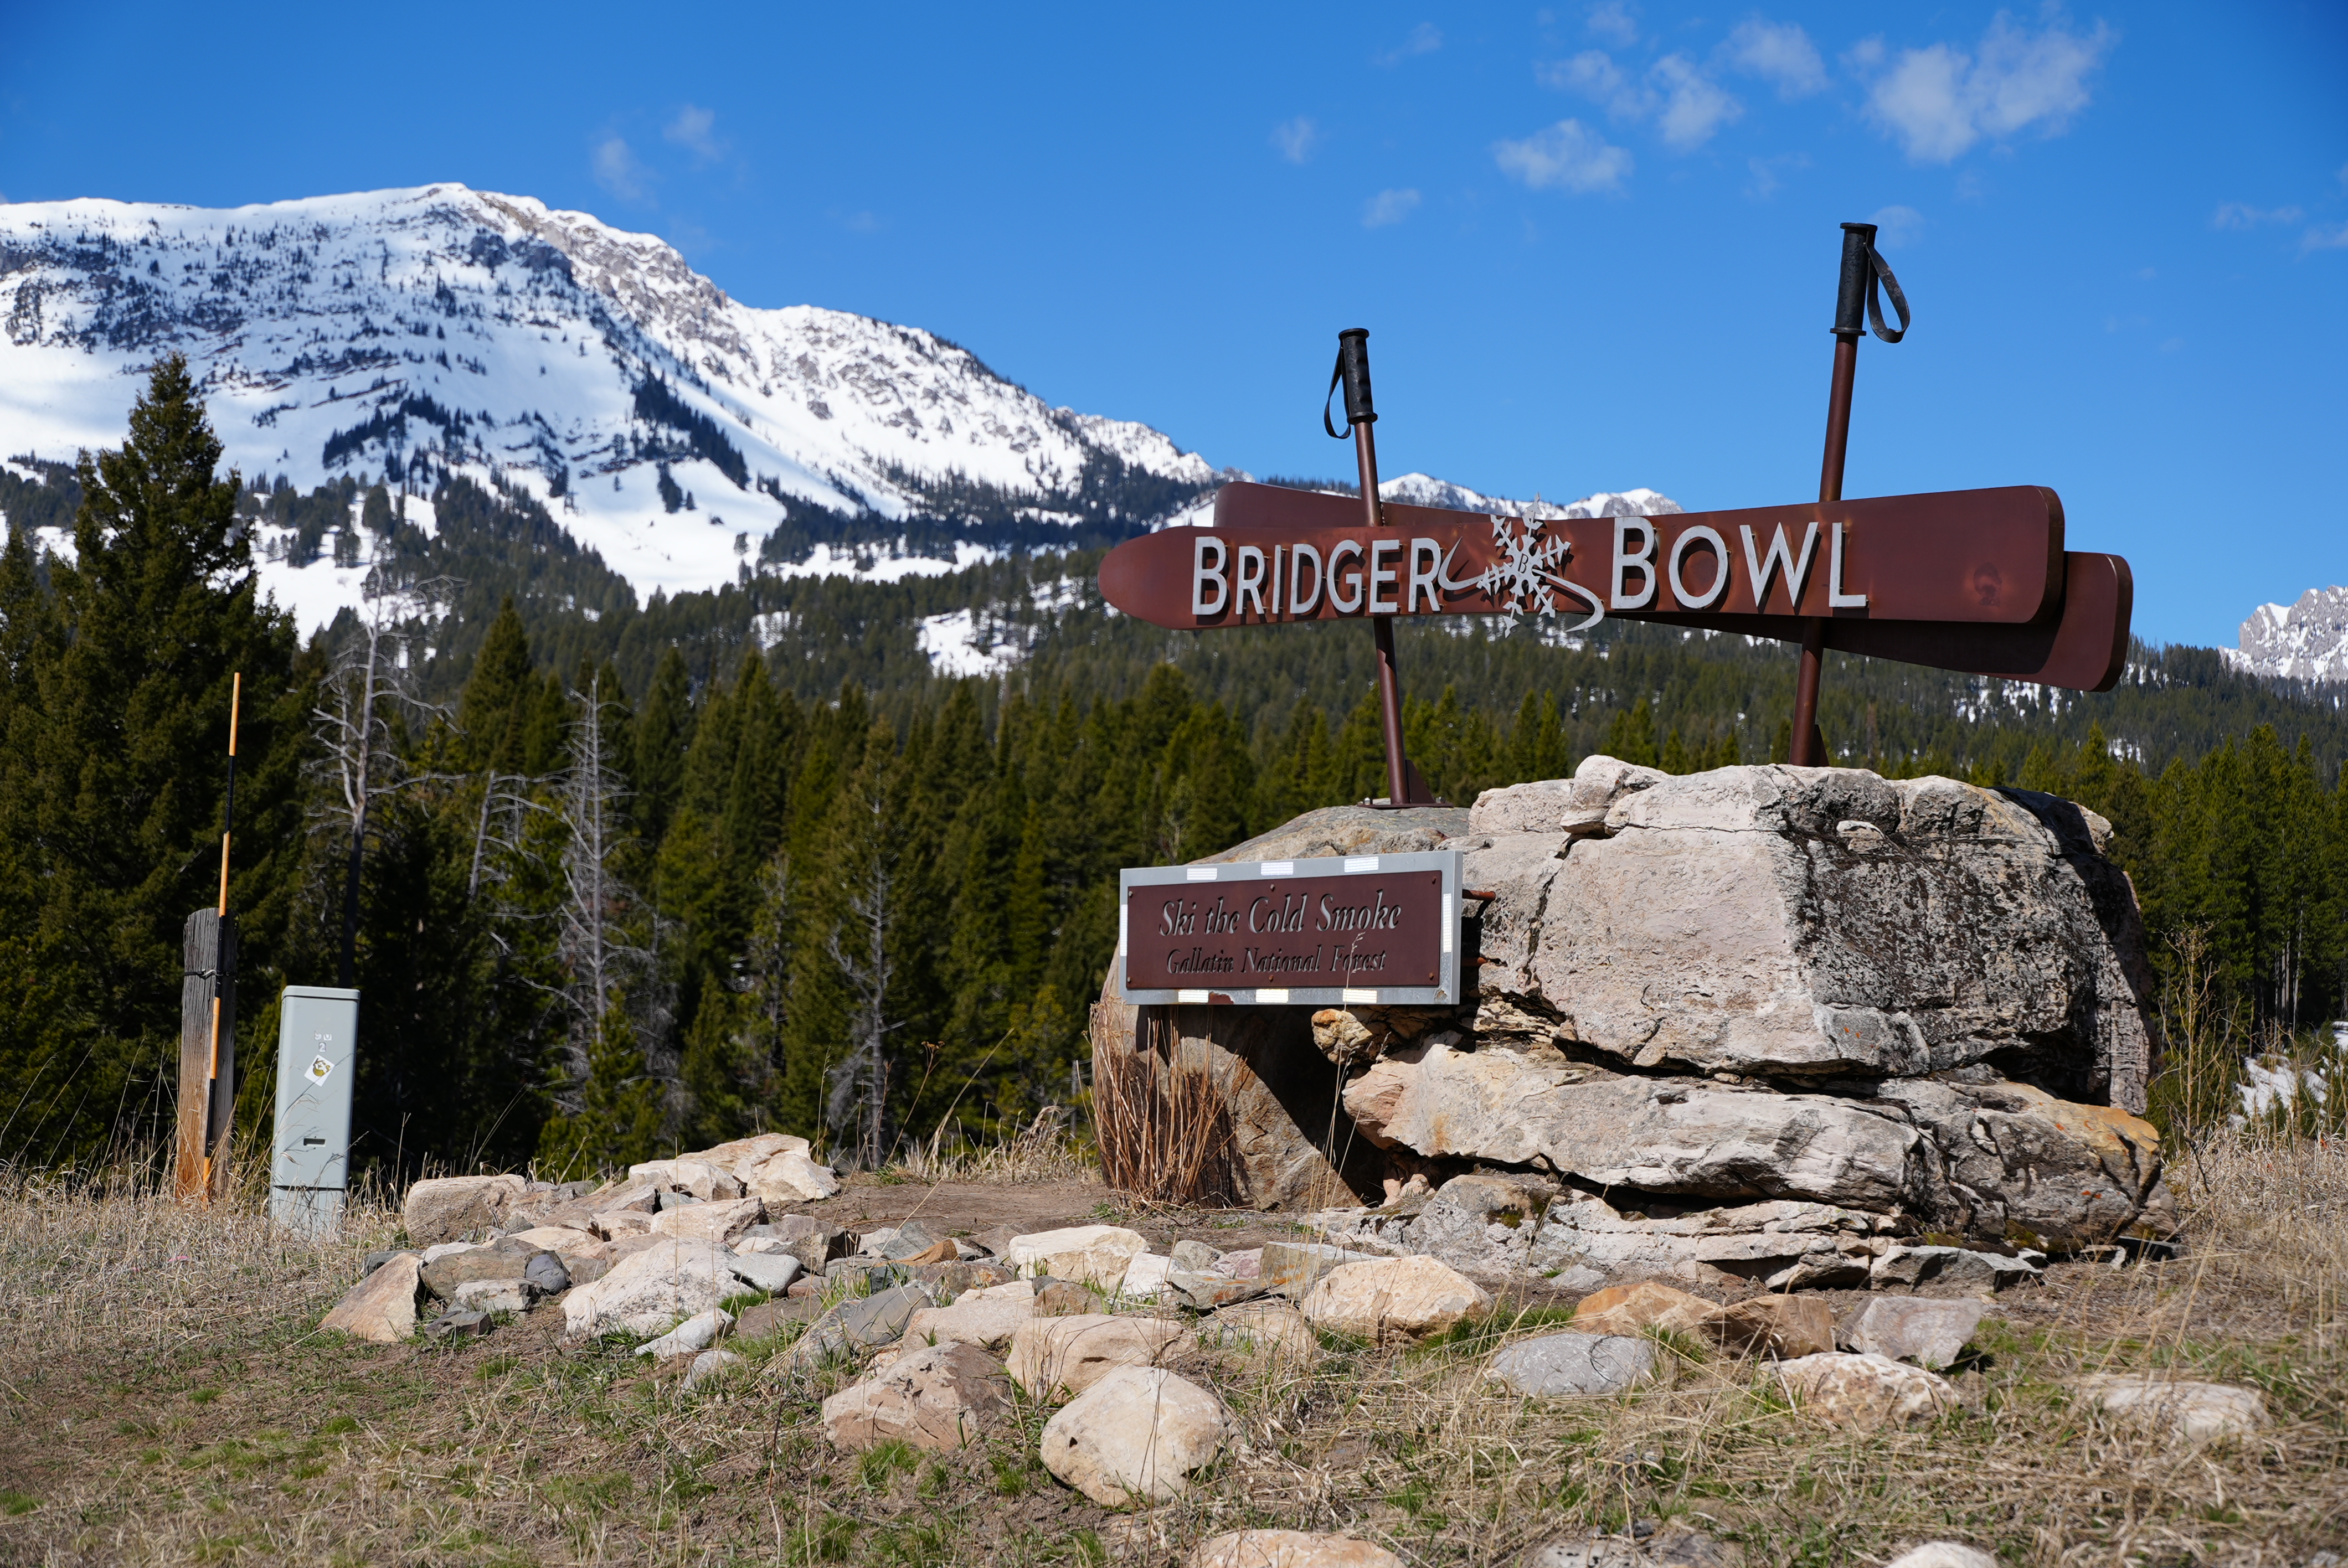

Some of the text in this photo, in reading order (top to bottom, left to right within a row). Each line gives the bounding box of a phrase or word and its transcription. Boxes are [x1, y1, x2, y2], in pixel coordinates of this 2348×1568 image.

[1192, 516, 1867, 615] BRIDGER BOWL
[1518, 553, 1528, 574] B
[1158, 888, 1402, 936] Ski the Cold Smoke
[1166, 944, 1387, 974] Gallatin National Forest
